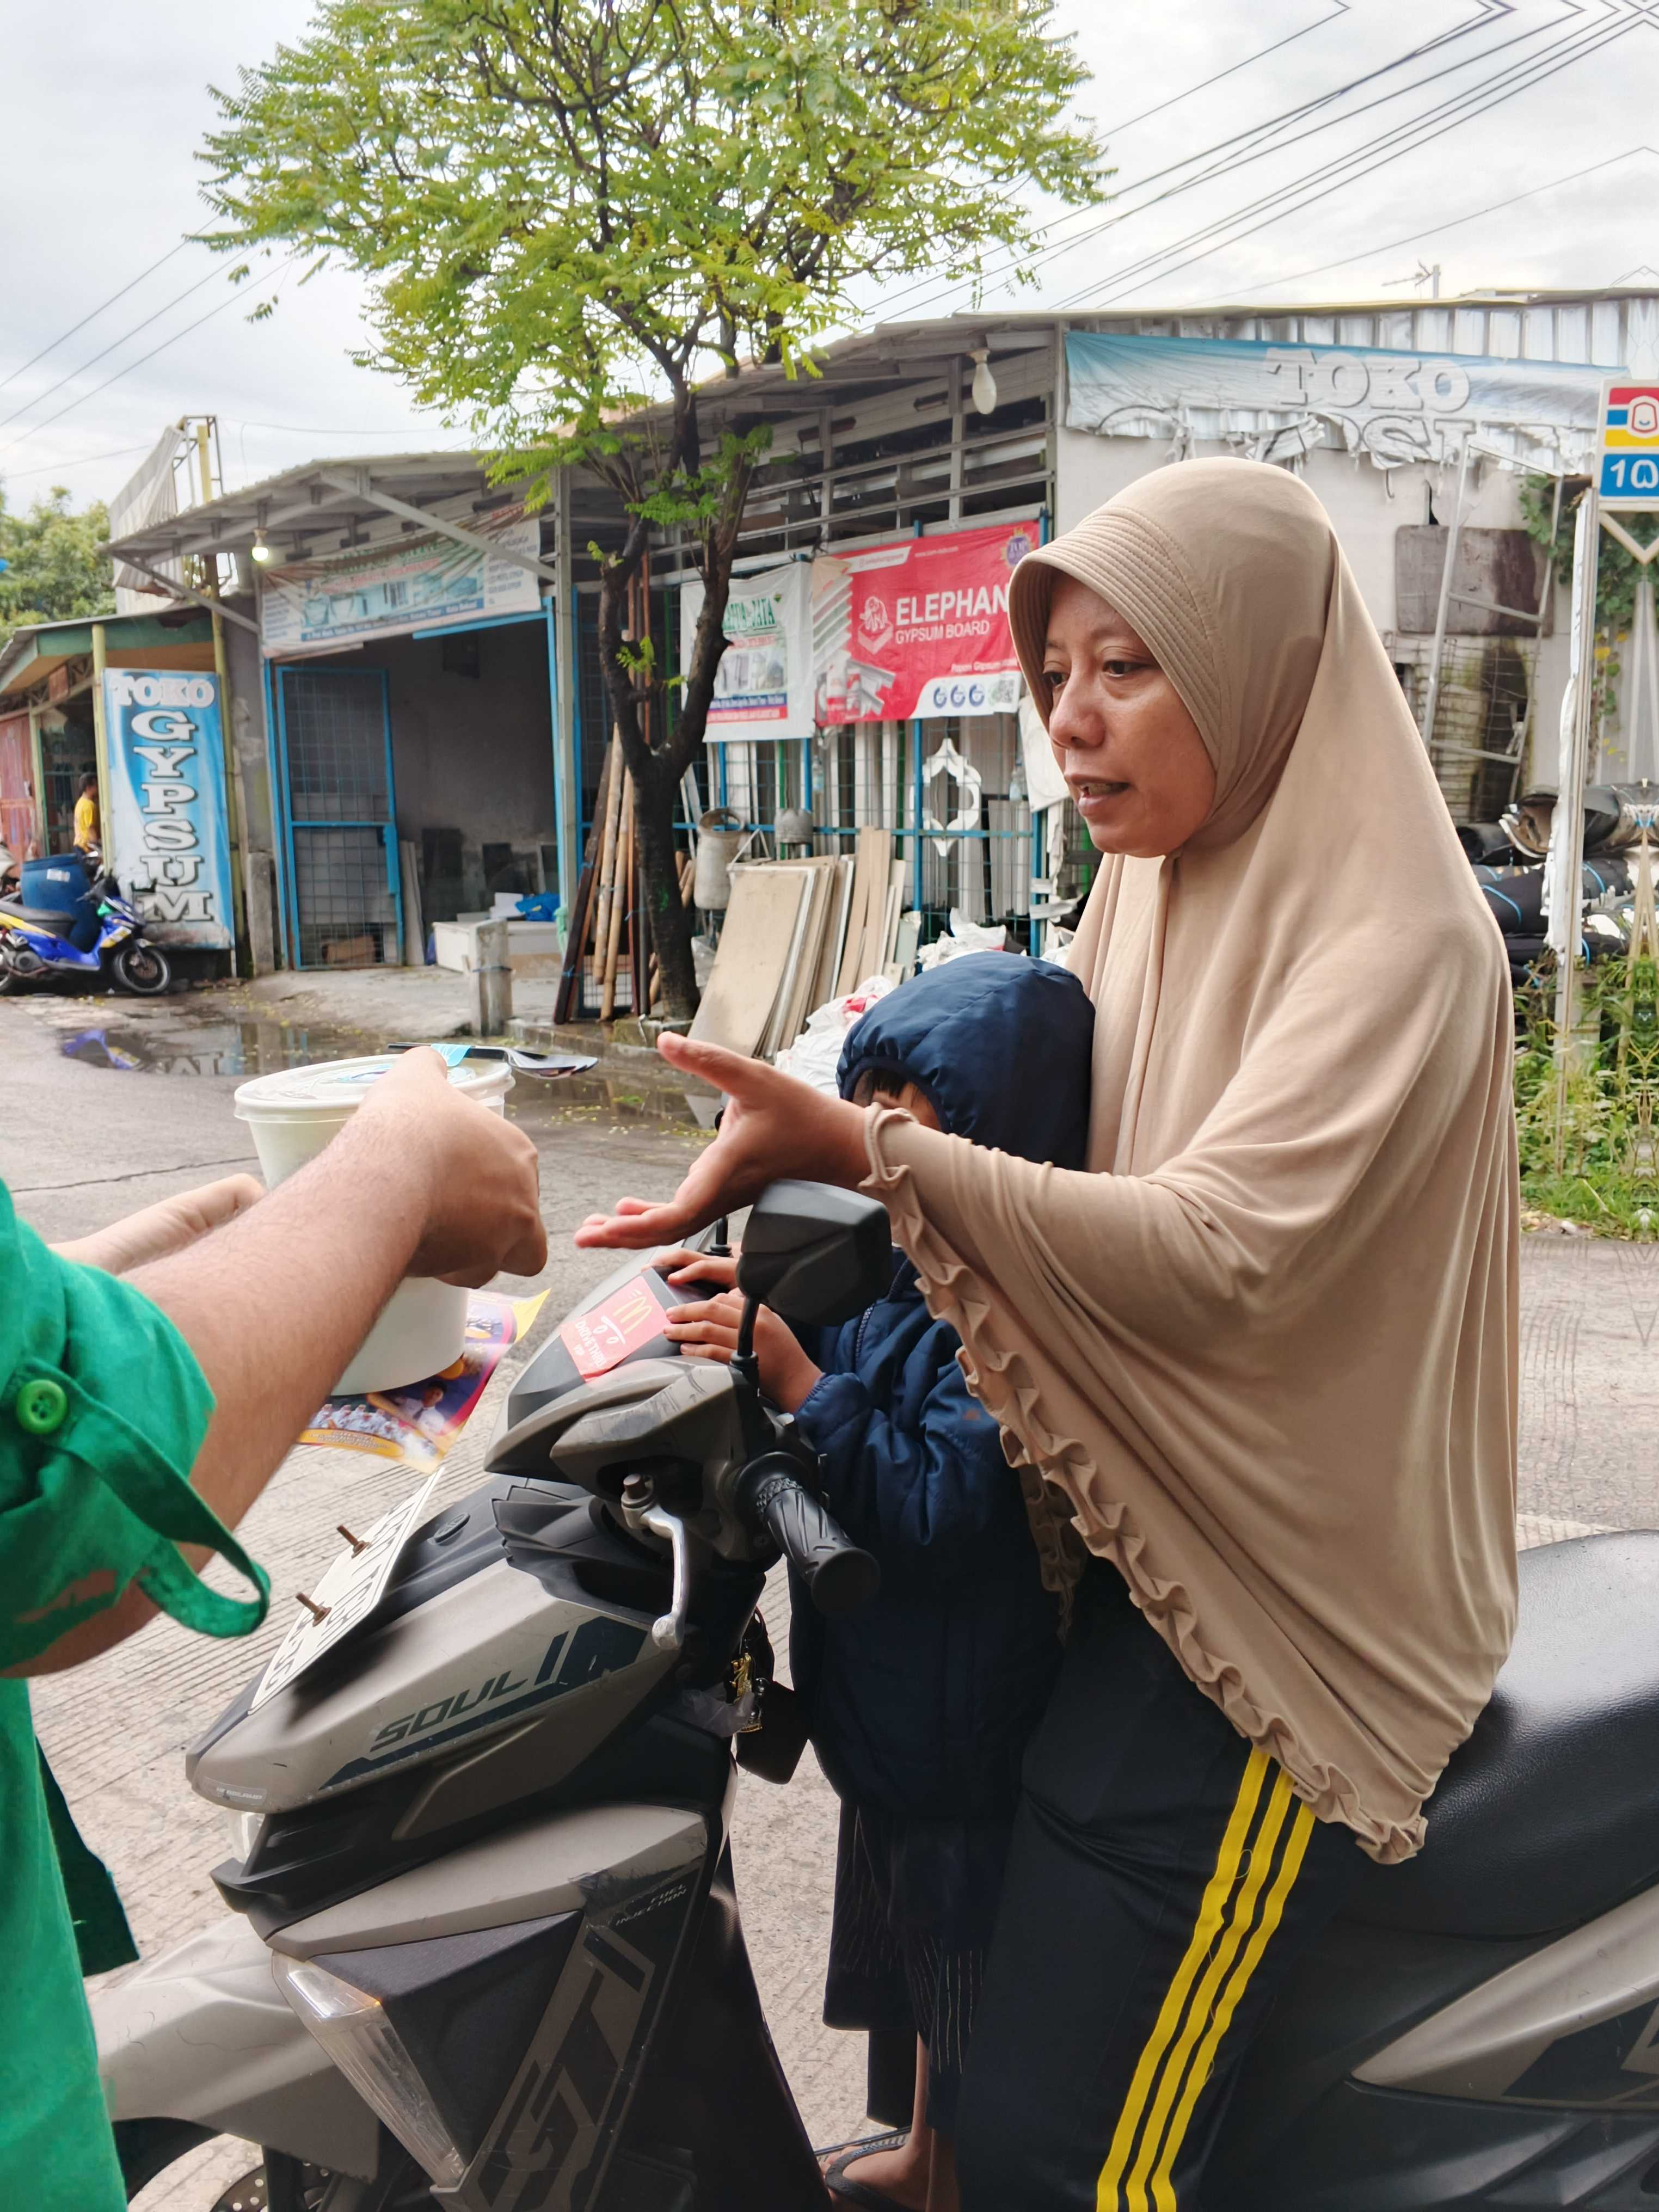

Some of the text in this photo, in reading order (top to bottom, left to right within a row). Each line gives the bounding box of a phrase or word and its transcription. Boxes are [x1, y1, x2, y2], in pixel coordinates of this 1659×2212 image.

[1265, 348, 1470, 413] TOKO
[896, 583, 1009, 626] ELEPHAN
[895, 620, 991, 644] GYPSUM BOARD
[110, 674, 215, 708] TOKO
[131, 709, 214, 923] GYPSUM
[370, 1670, 529, 1752] SOUL
[616, 1889, 687, 1926] INJECTION
[650, 1884, 686, 1903] FUEL
